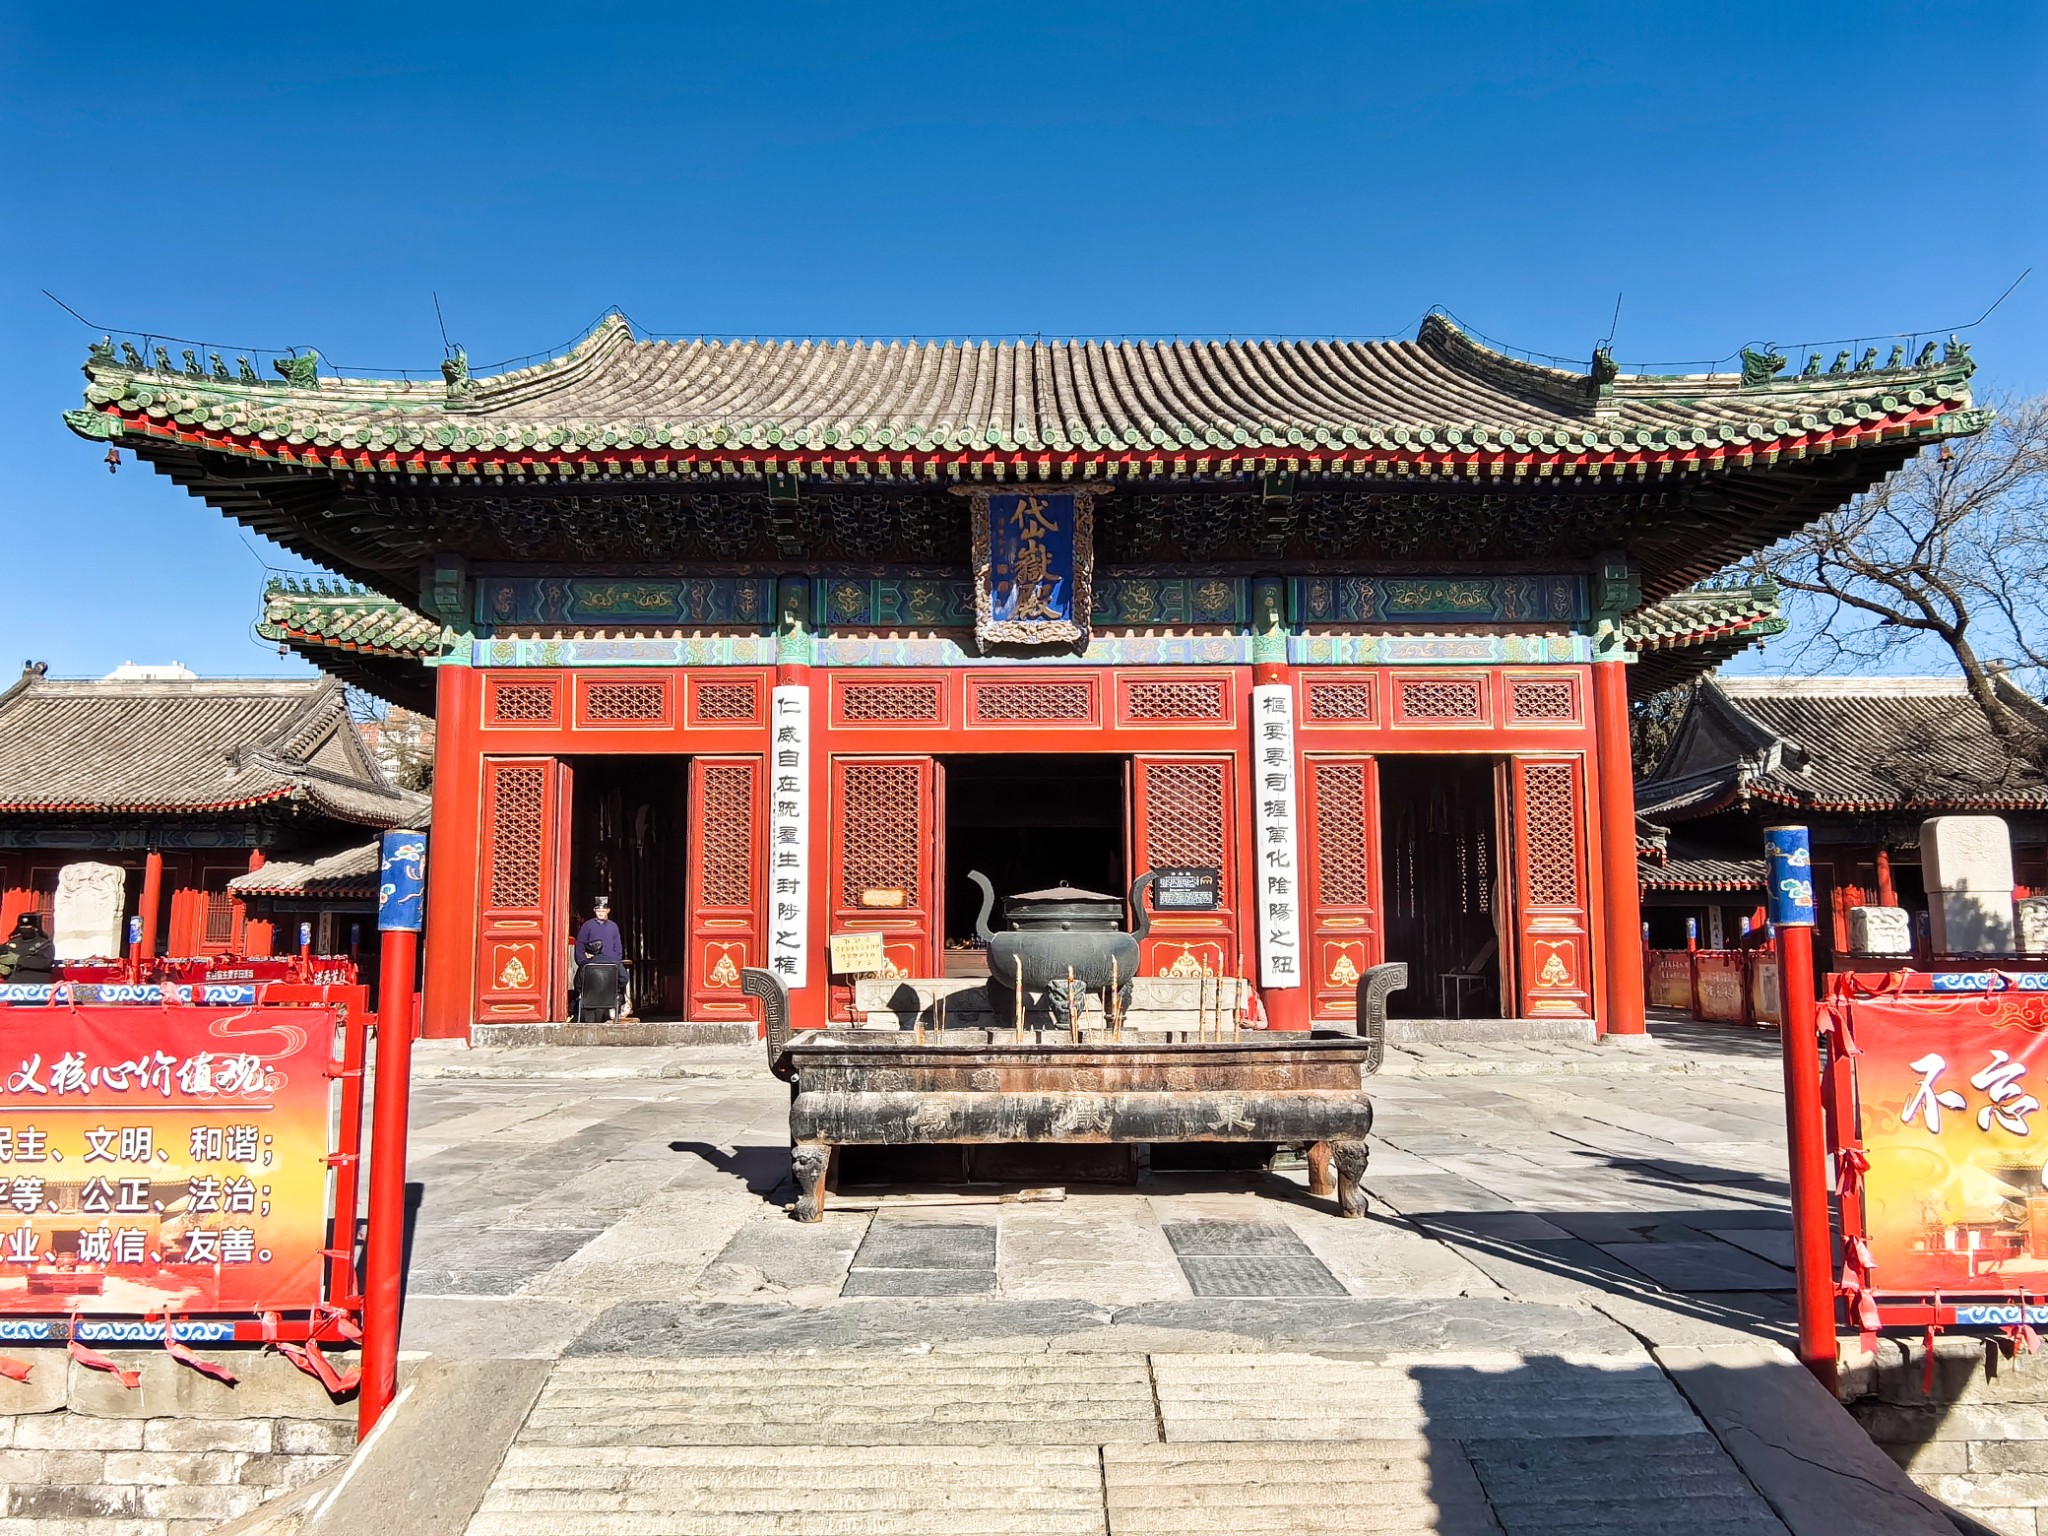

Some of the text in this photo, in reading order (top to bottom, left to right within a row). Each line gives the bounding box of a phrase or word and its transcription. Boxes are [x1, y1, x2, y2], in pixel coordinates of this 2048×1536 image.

[0, 1050, 275, 1097] 义核心价值观：
[1901, 1049, 2040, 1136] 不忘
[0, 1226, 273, 1264] 业、诚信、友善。
